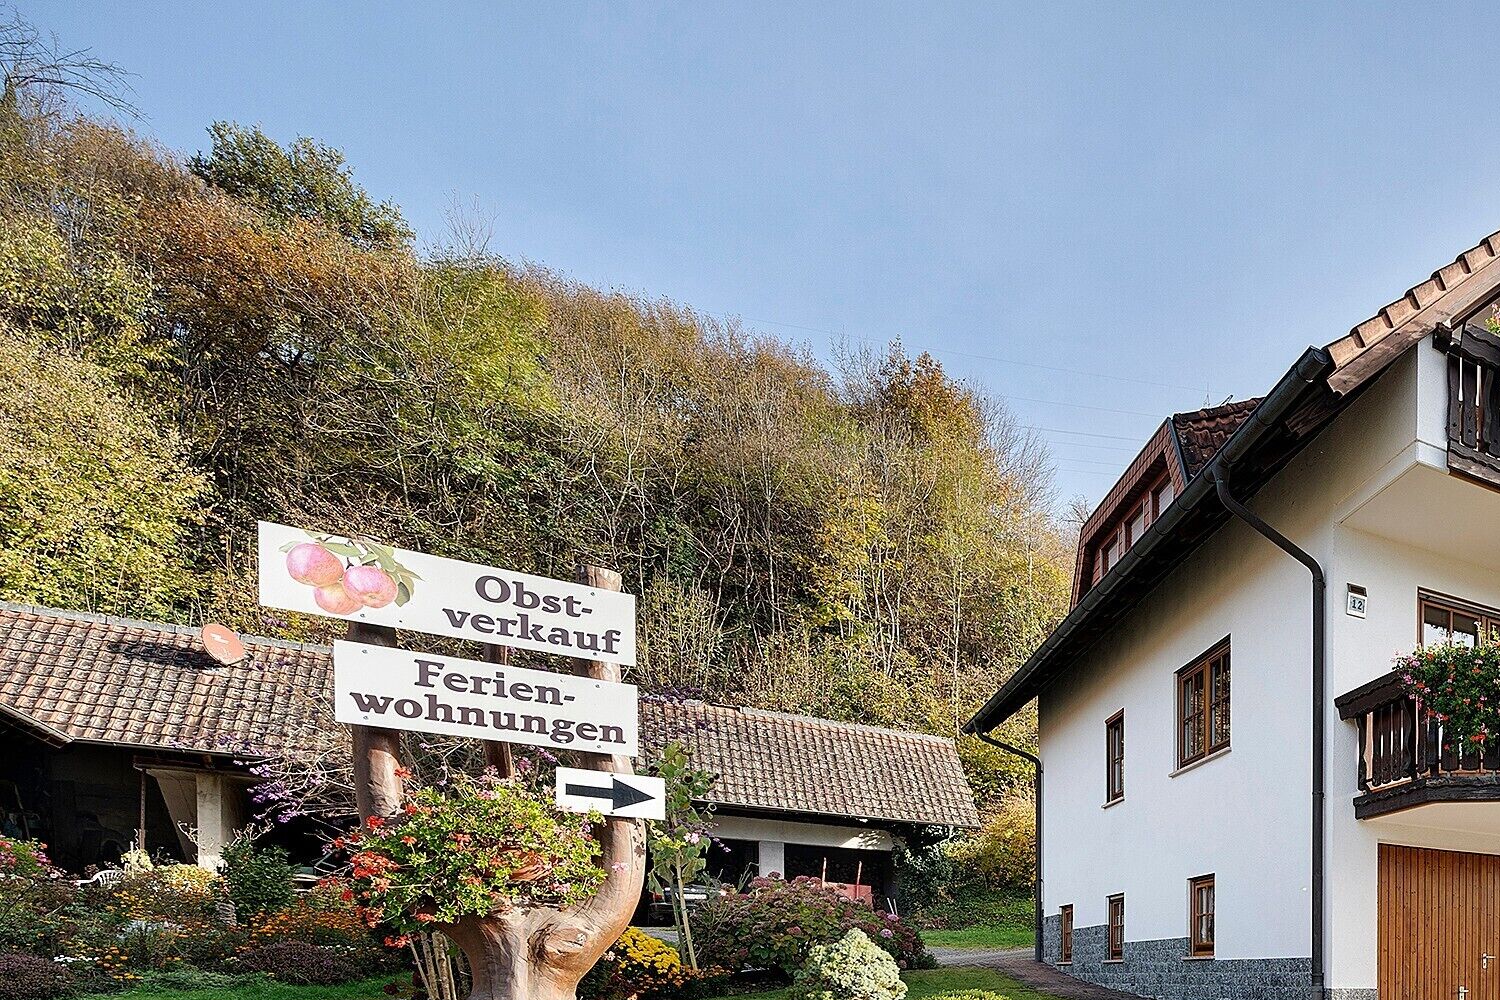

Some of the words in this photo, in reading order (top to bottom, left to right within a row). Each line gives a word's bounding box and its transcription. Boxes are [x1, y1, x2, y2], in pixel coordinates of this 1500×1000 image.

[474, 575, 593, 618] Obst-
[1352, 599, 1363, 610] 12
[442, 607, 622, 655] verkauf
[413, 658, 576, 708] Ferien-
[349, 691, 627, 745] wohnungen
